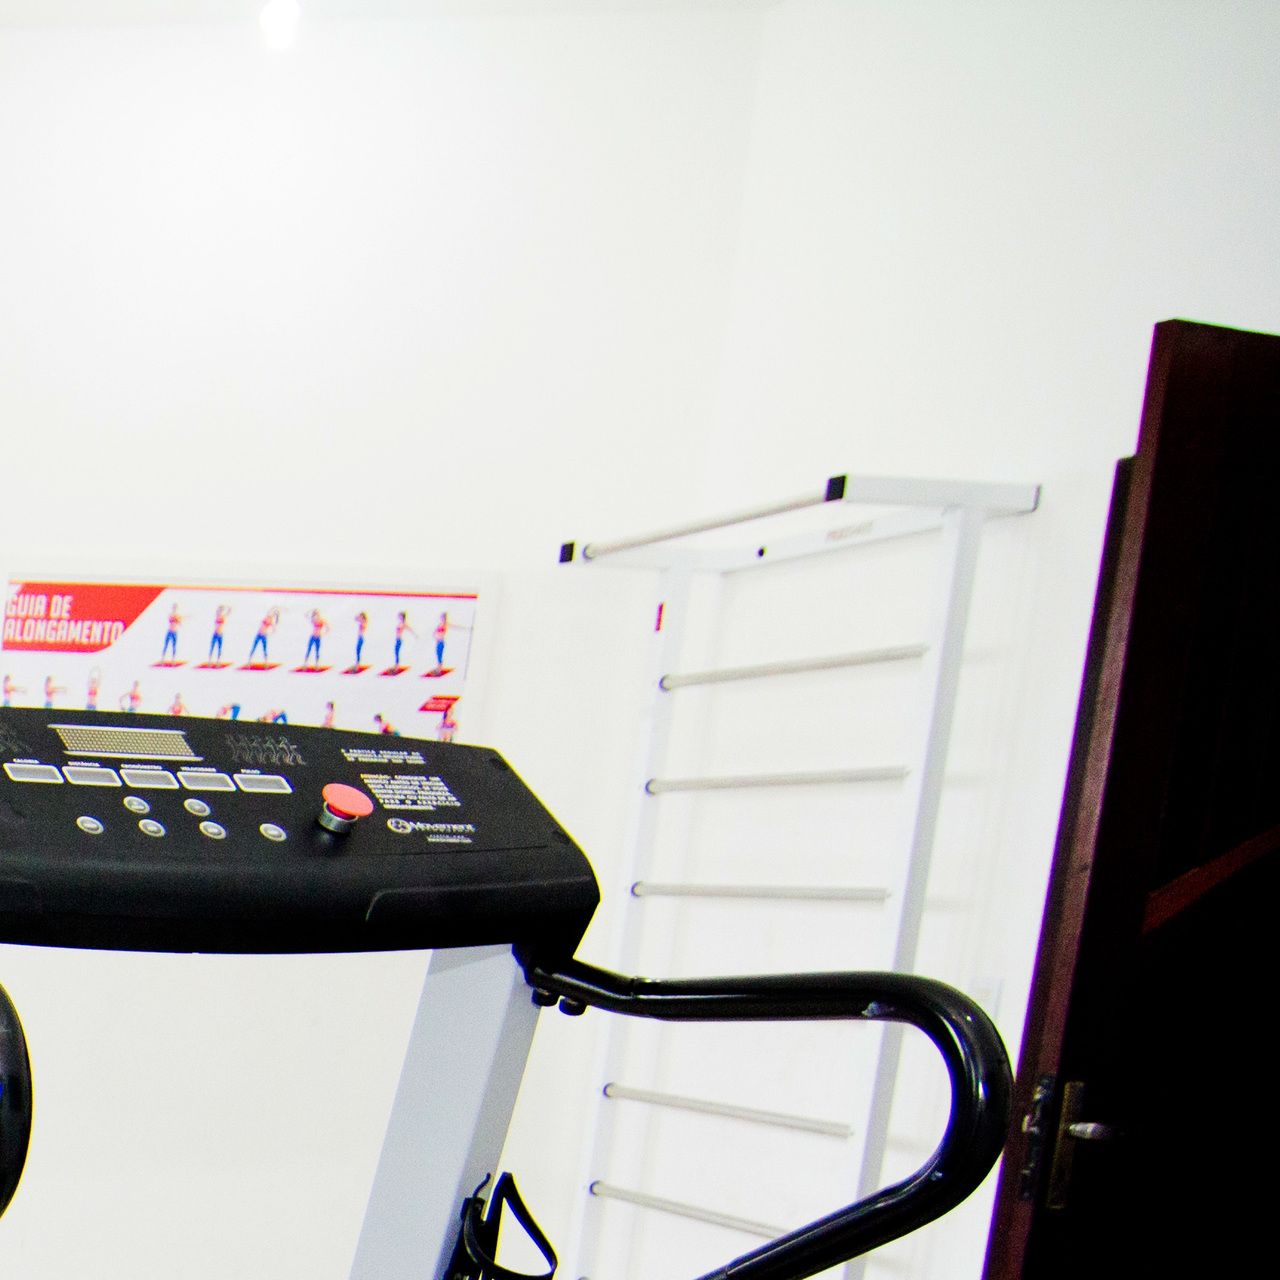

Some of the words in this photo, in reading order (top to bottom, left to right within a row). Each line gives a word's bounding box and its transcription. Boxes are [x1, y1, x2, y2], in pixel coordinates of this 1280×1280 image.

[6, 594, 47, 617] GUIA
[50, 595, 73, 618] DE
[3, 618, 126, 644] ALONGAMENTO
